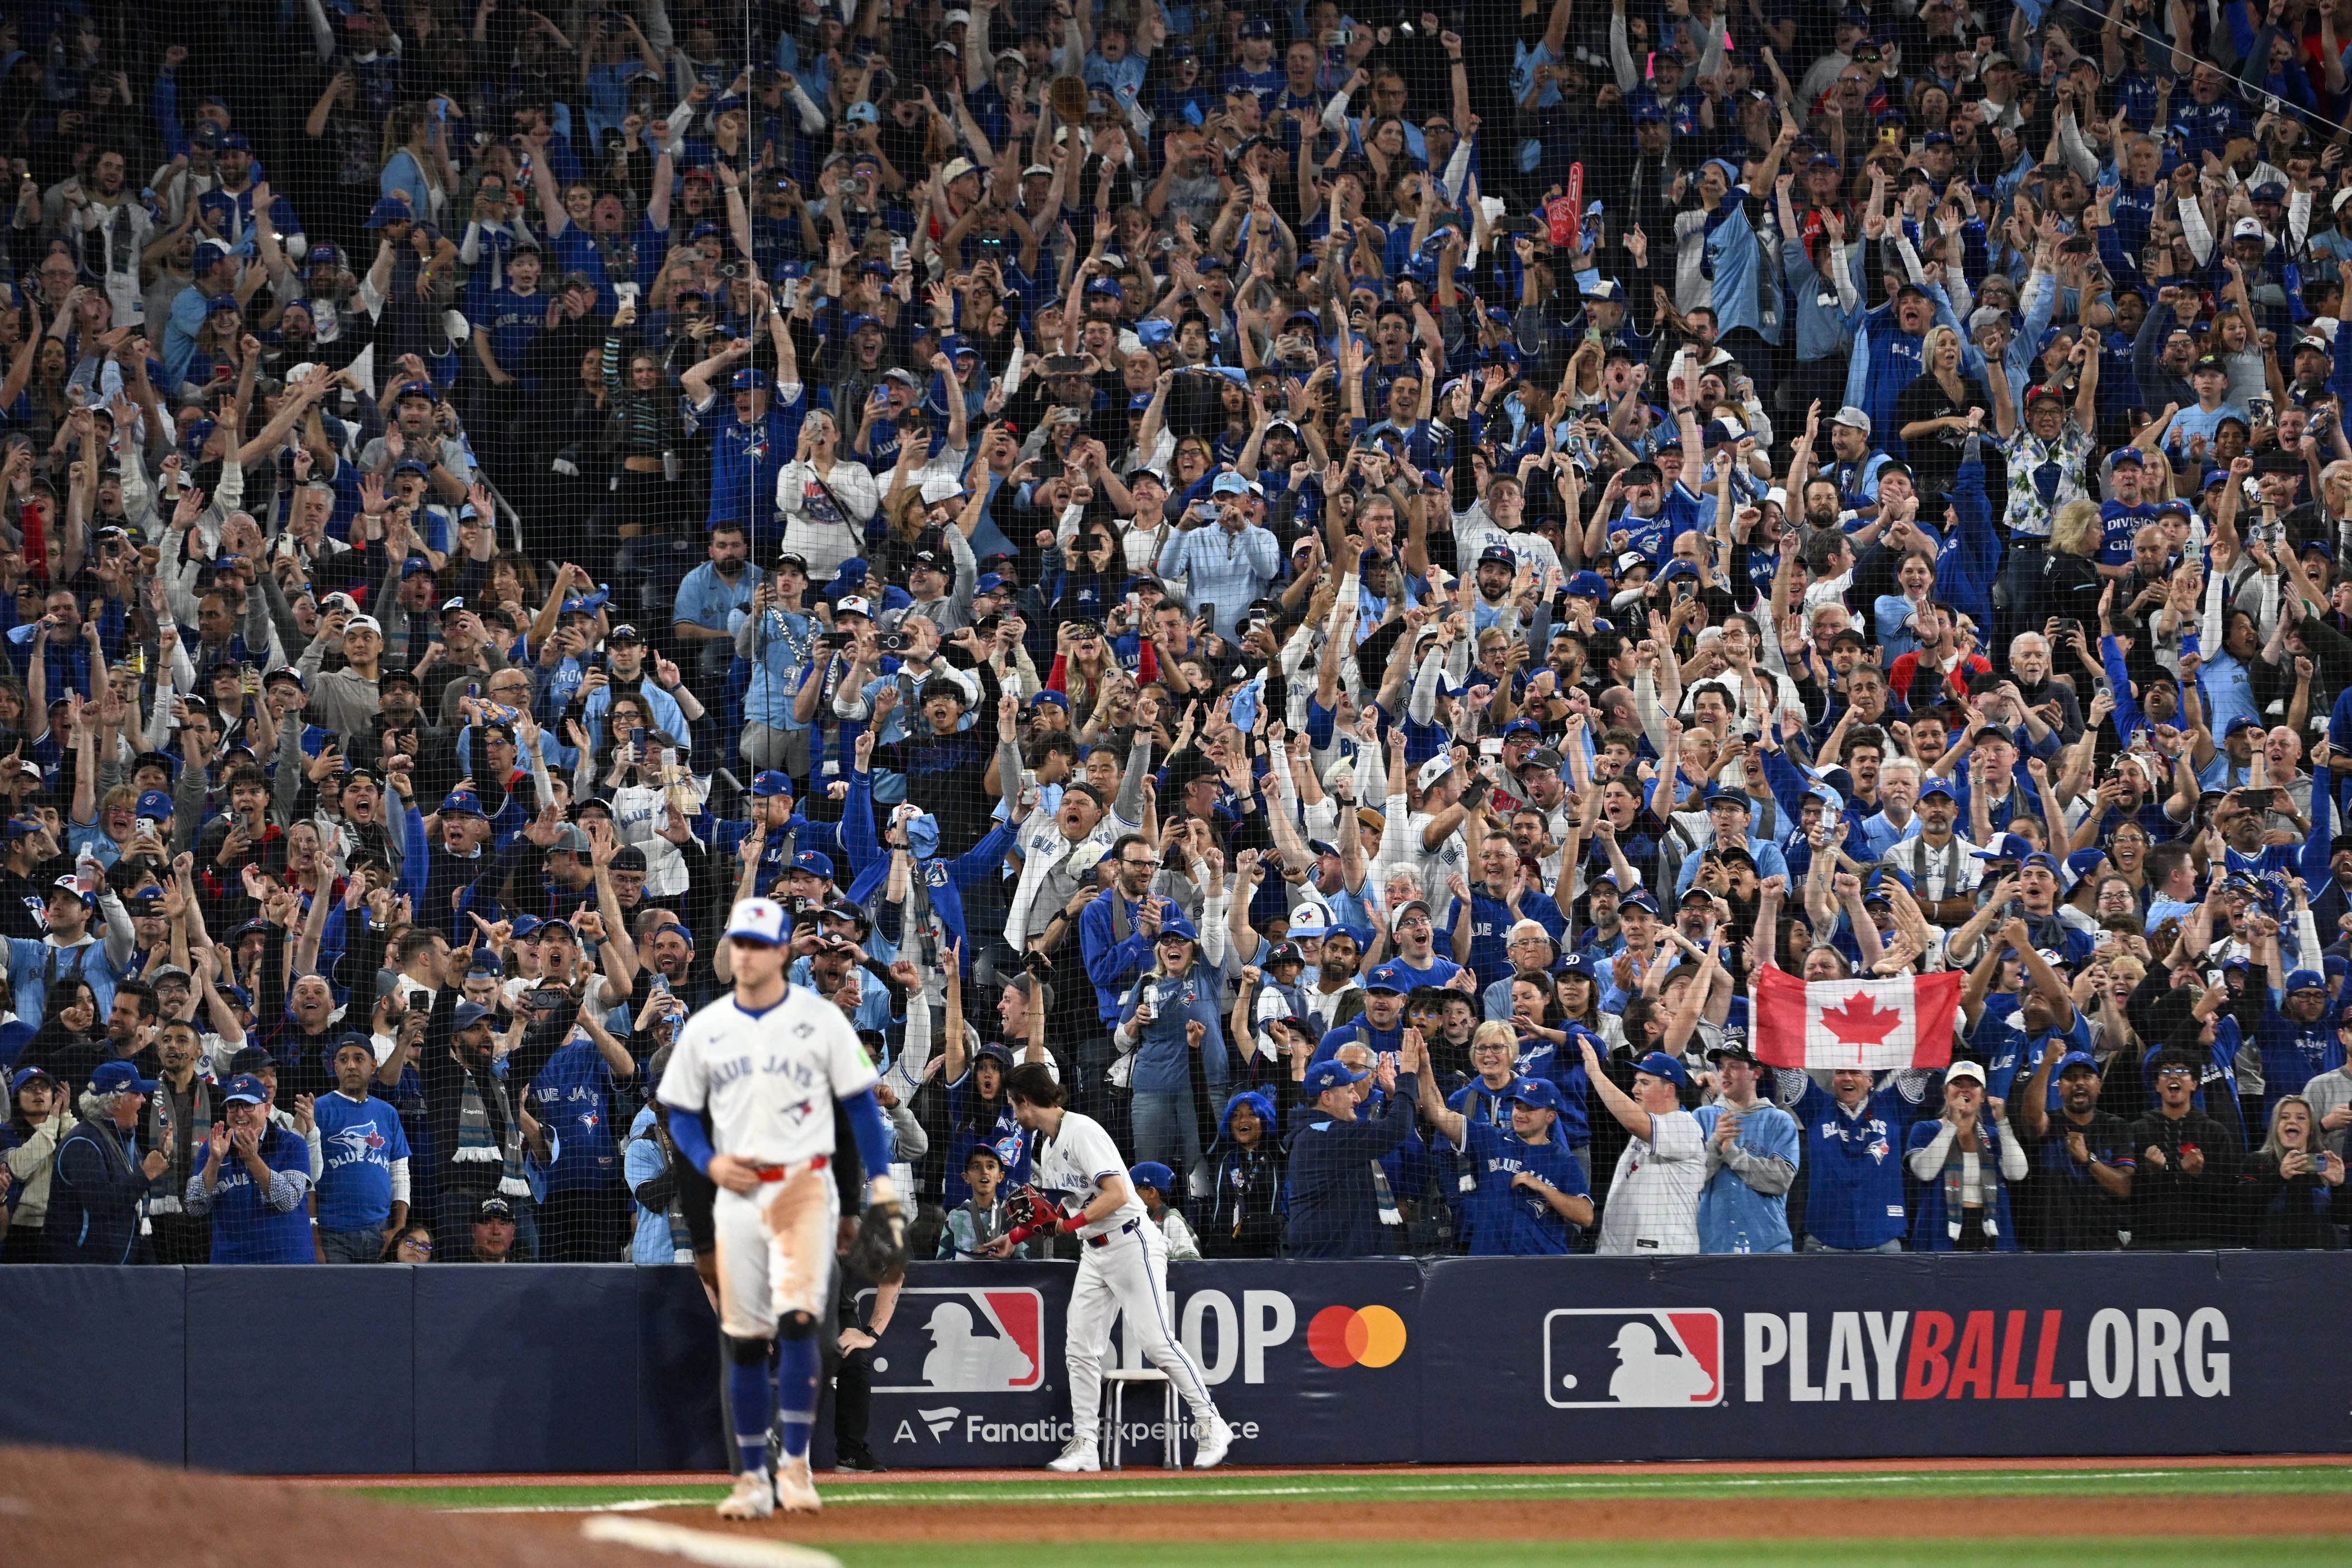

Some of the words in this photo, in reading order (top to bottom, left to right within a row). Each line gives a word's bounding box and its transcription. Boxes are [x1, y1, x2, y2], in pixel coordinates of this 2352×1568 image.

[2109, 539, 2135, 552] CHA
[1566, 954, 1580, 966] D
[762, 1055, 814, 1089] JAYS
[328, 1149, 366, 1169] BLUE
[1487, 1157, 1523, 1174] BLUE
[217, 1173, 251, 1194] BLUE
[1061, 1172, 1089, 1188] JAYS
[1744, 1307, 2231, 1401] PLAYBALL.ORG
[892, 1420, 917, 1444] A
[966, 1415, 1075, 1443] Fanatic
